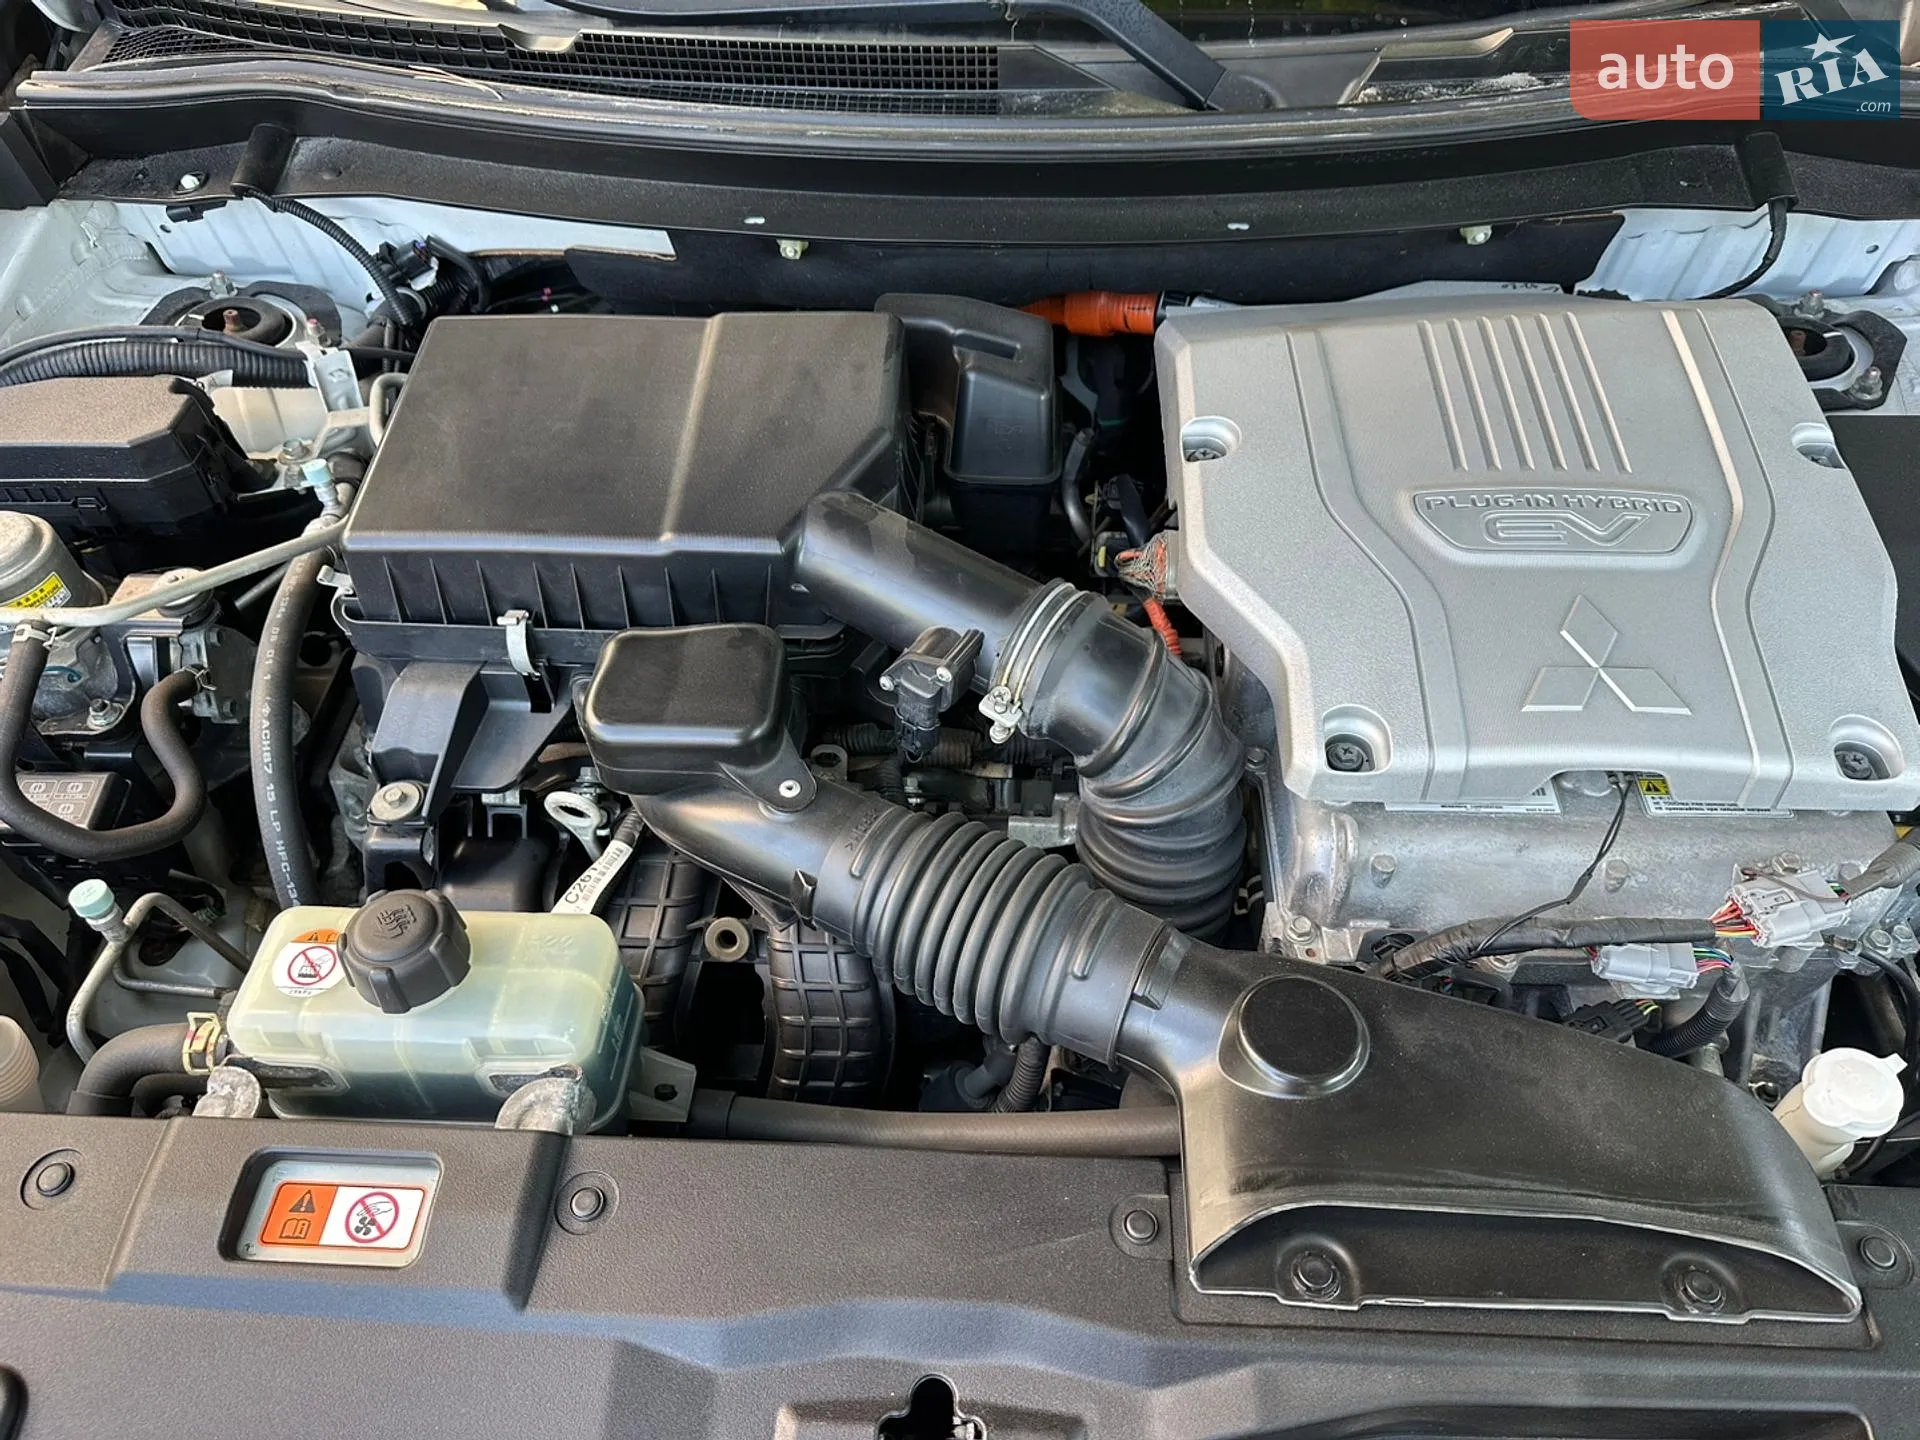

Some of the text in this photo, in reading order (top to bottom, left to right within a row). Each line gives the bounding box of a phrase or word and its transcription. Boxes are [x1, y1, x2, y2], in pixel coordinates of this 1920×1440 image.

[1425, 494, 1683, 513] PLUG-IN HYBRID
[1483, 510, 1650, 546] EV
